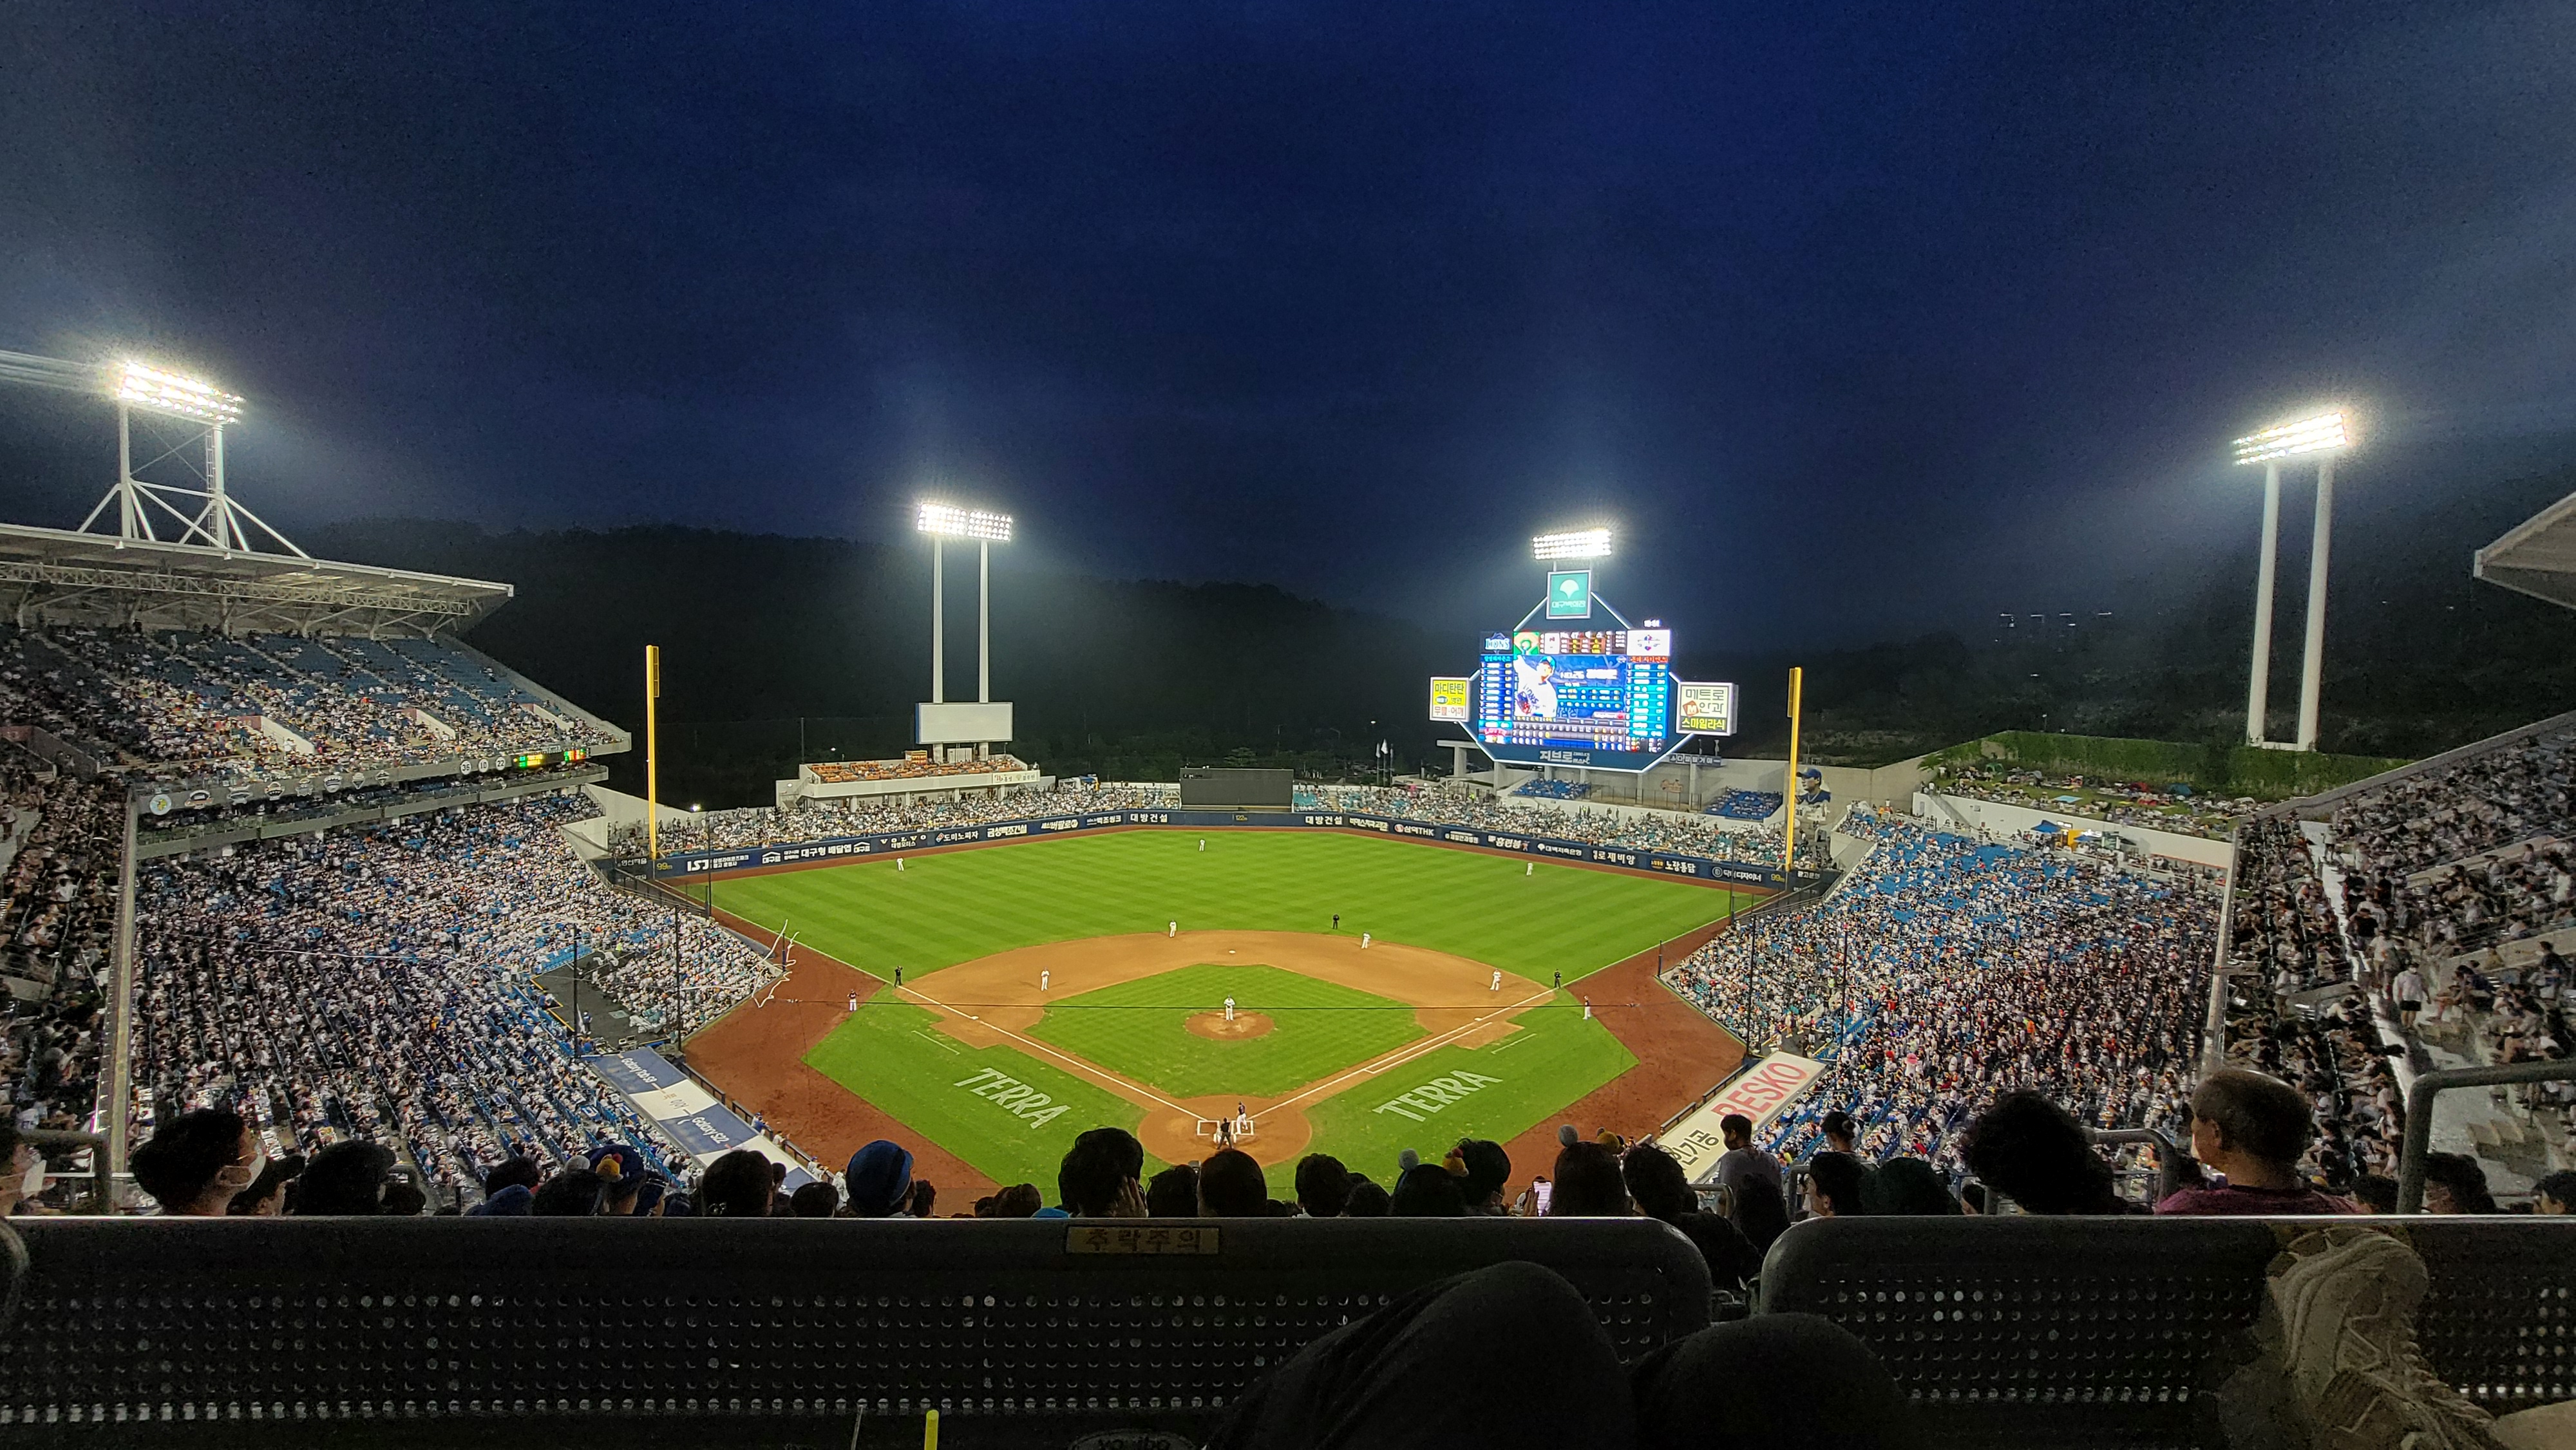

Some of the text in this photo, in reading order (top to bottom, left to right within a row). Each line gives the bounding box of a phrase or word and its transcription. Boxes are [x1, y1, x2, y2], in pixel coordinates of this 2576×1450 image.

[1435, 683, 1464, 695] 마디탄탄
[1685, 689, 1724, 701] 메트로
[1700, 702, 1724, 714] 안과
[1681, 717, 1725, 730] 스마일라식
[1539, 750, 1573, 763] 지브로
[1130, 813, 1168, 823] 대방건설
[1305, 815, 1343, 825] 대방건설
[943, 831, 979, 842] 도미노피자
[1404, 825, 1435, 836] 삼익THK
[880, 834, 927, 844] VOLVO
[801, 844, 852, 858] 대구형 배달앱
[1545, 845, 1582, 856] 대백저축은행
[1598, 851, 1636, 865] 로제비앙
[1665, 860, 1696, 874] 노랑통닭
[1771, 874, 1785, 883] 99m
[953, 1067, 1072, 1129] TERRA
[1372, 1069, 1504, 1122] TERRA
[1710, 1062, 1808, 1124] BESKO
[1084, 1228, 1202, 1252] 추락주의
